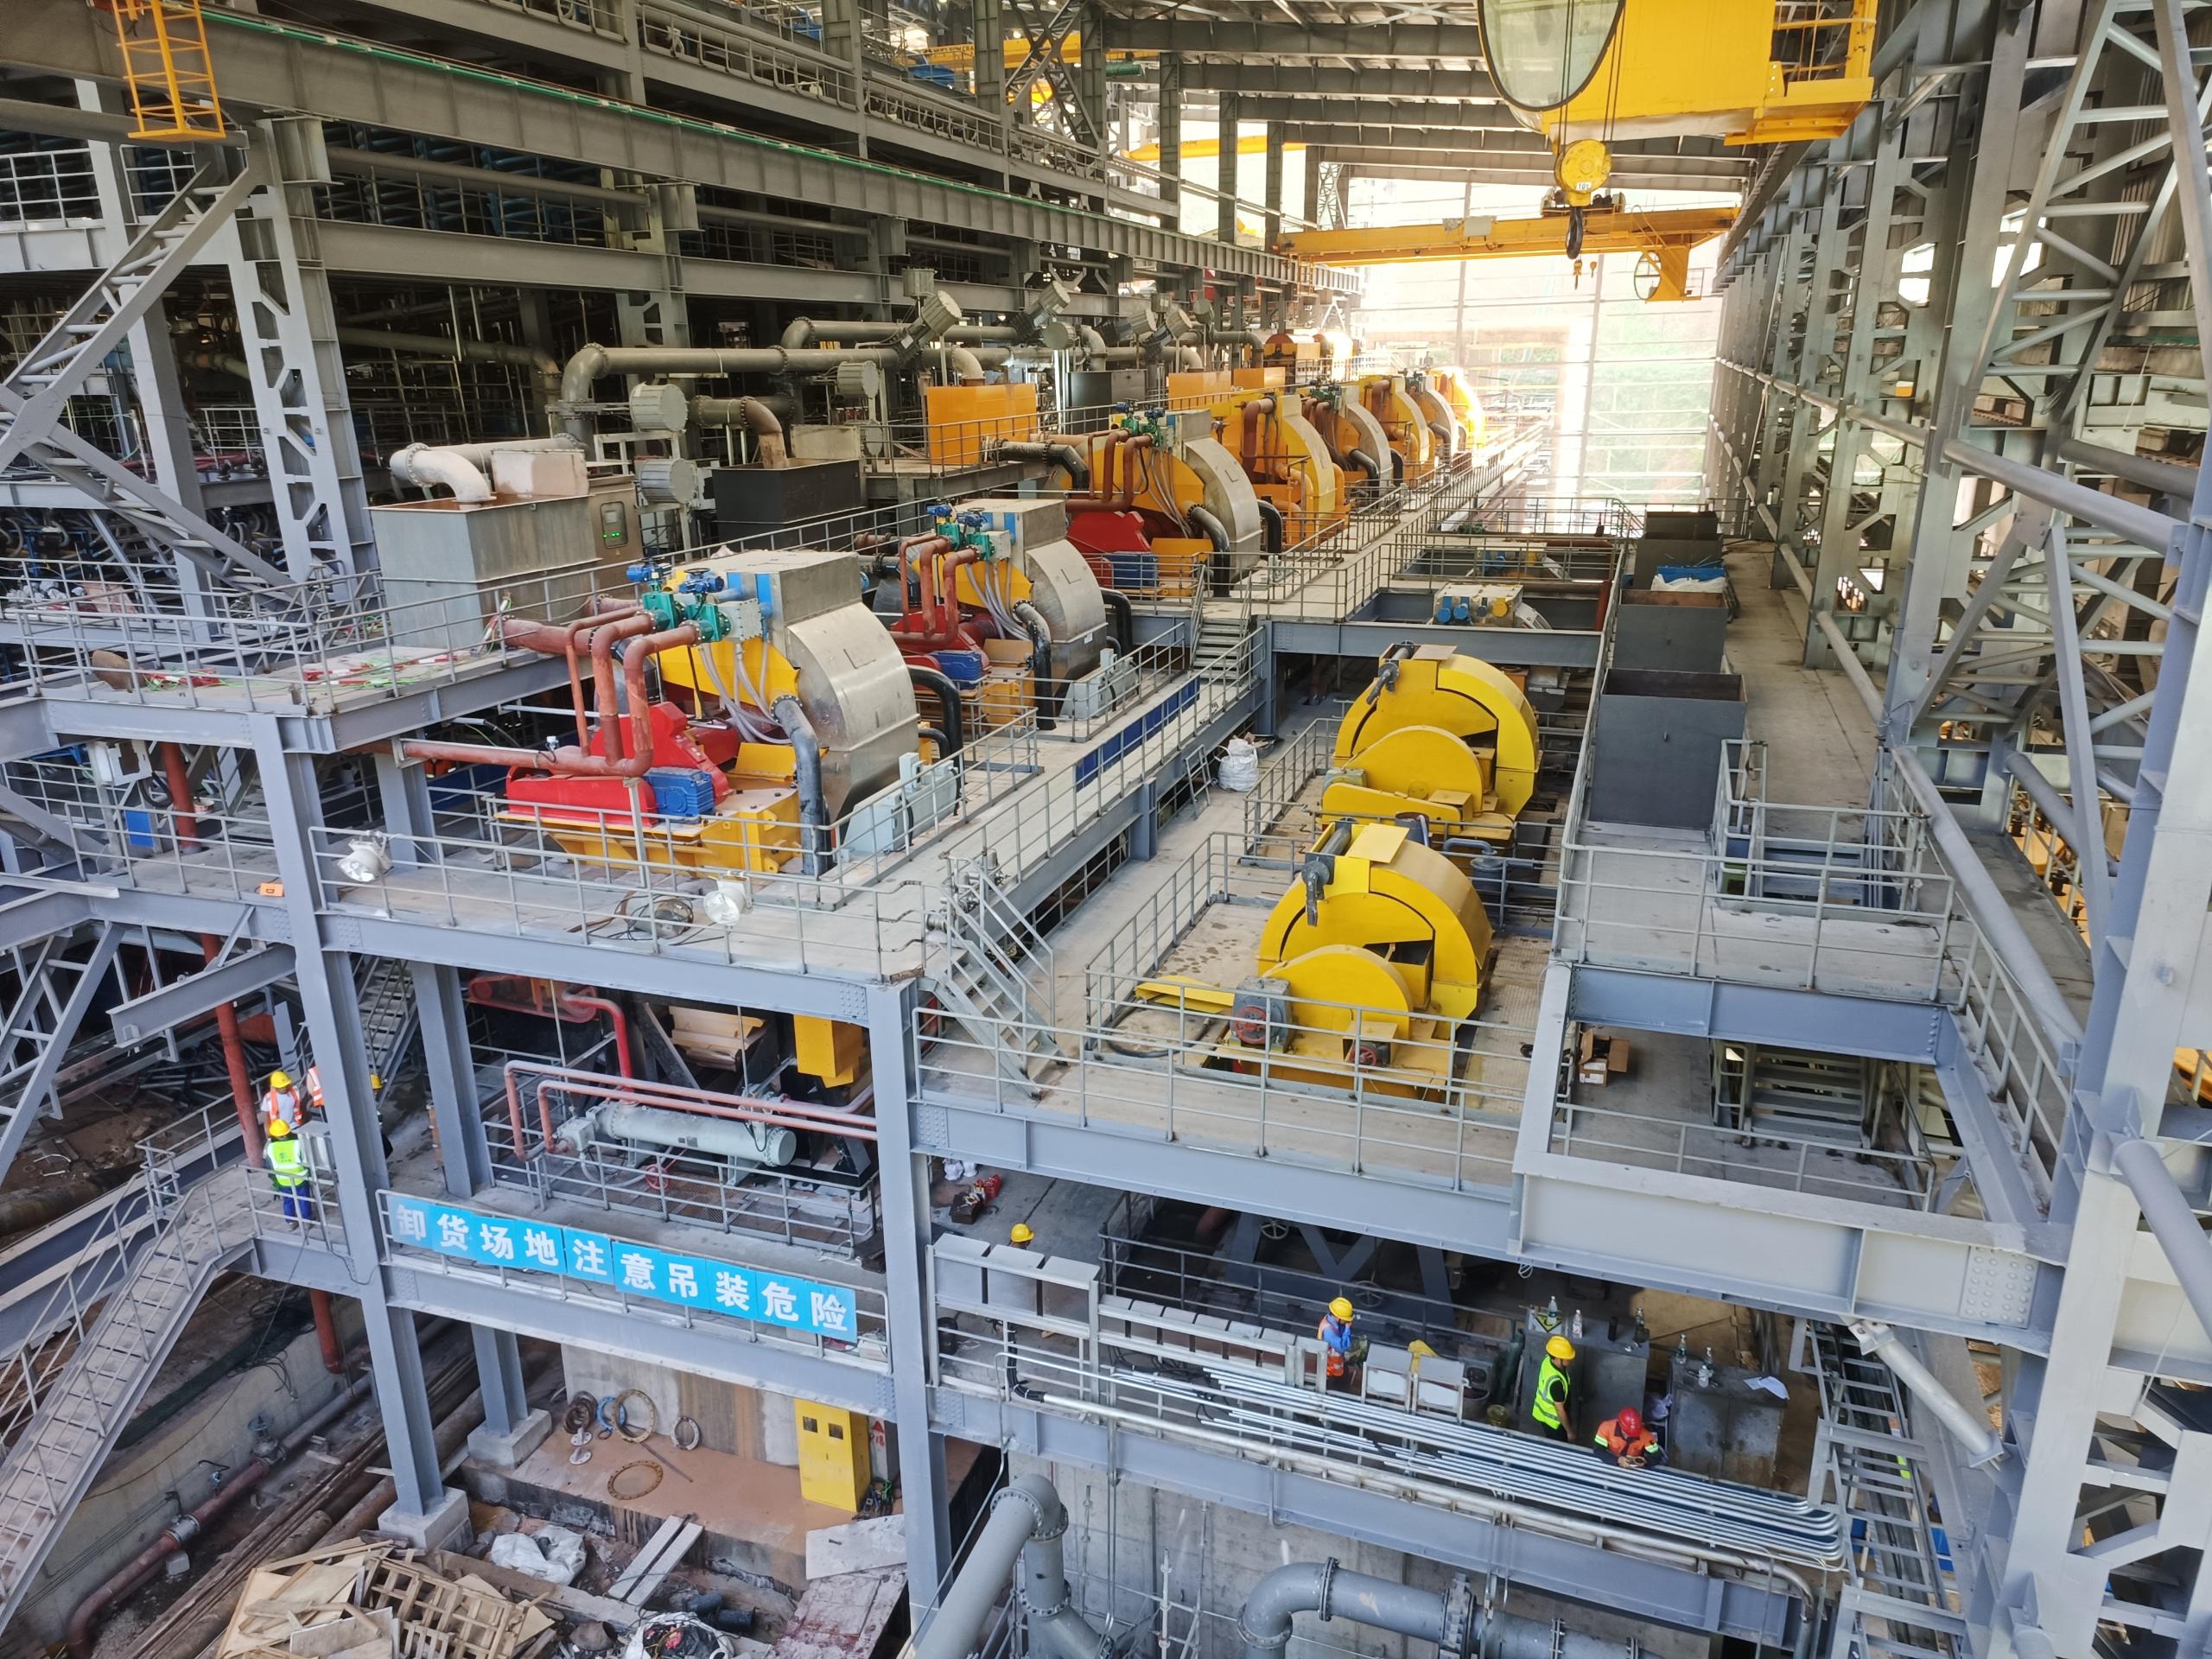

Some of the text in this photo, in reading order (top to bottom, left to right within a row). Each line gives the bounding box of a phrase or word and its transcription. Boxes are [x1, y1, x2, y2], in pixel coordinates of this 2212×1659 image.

[397, 1204, 848, 1332] 卸货场地注意吊装危险
